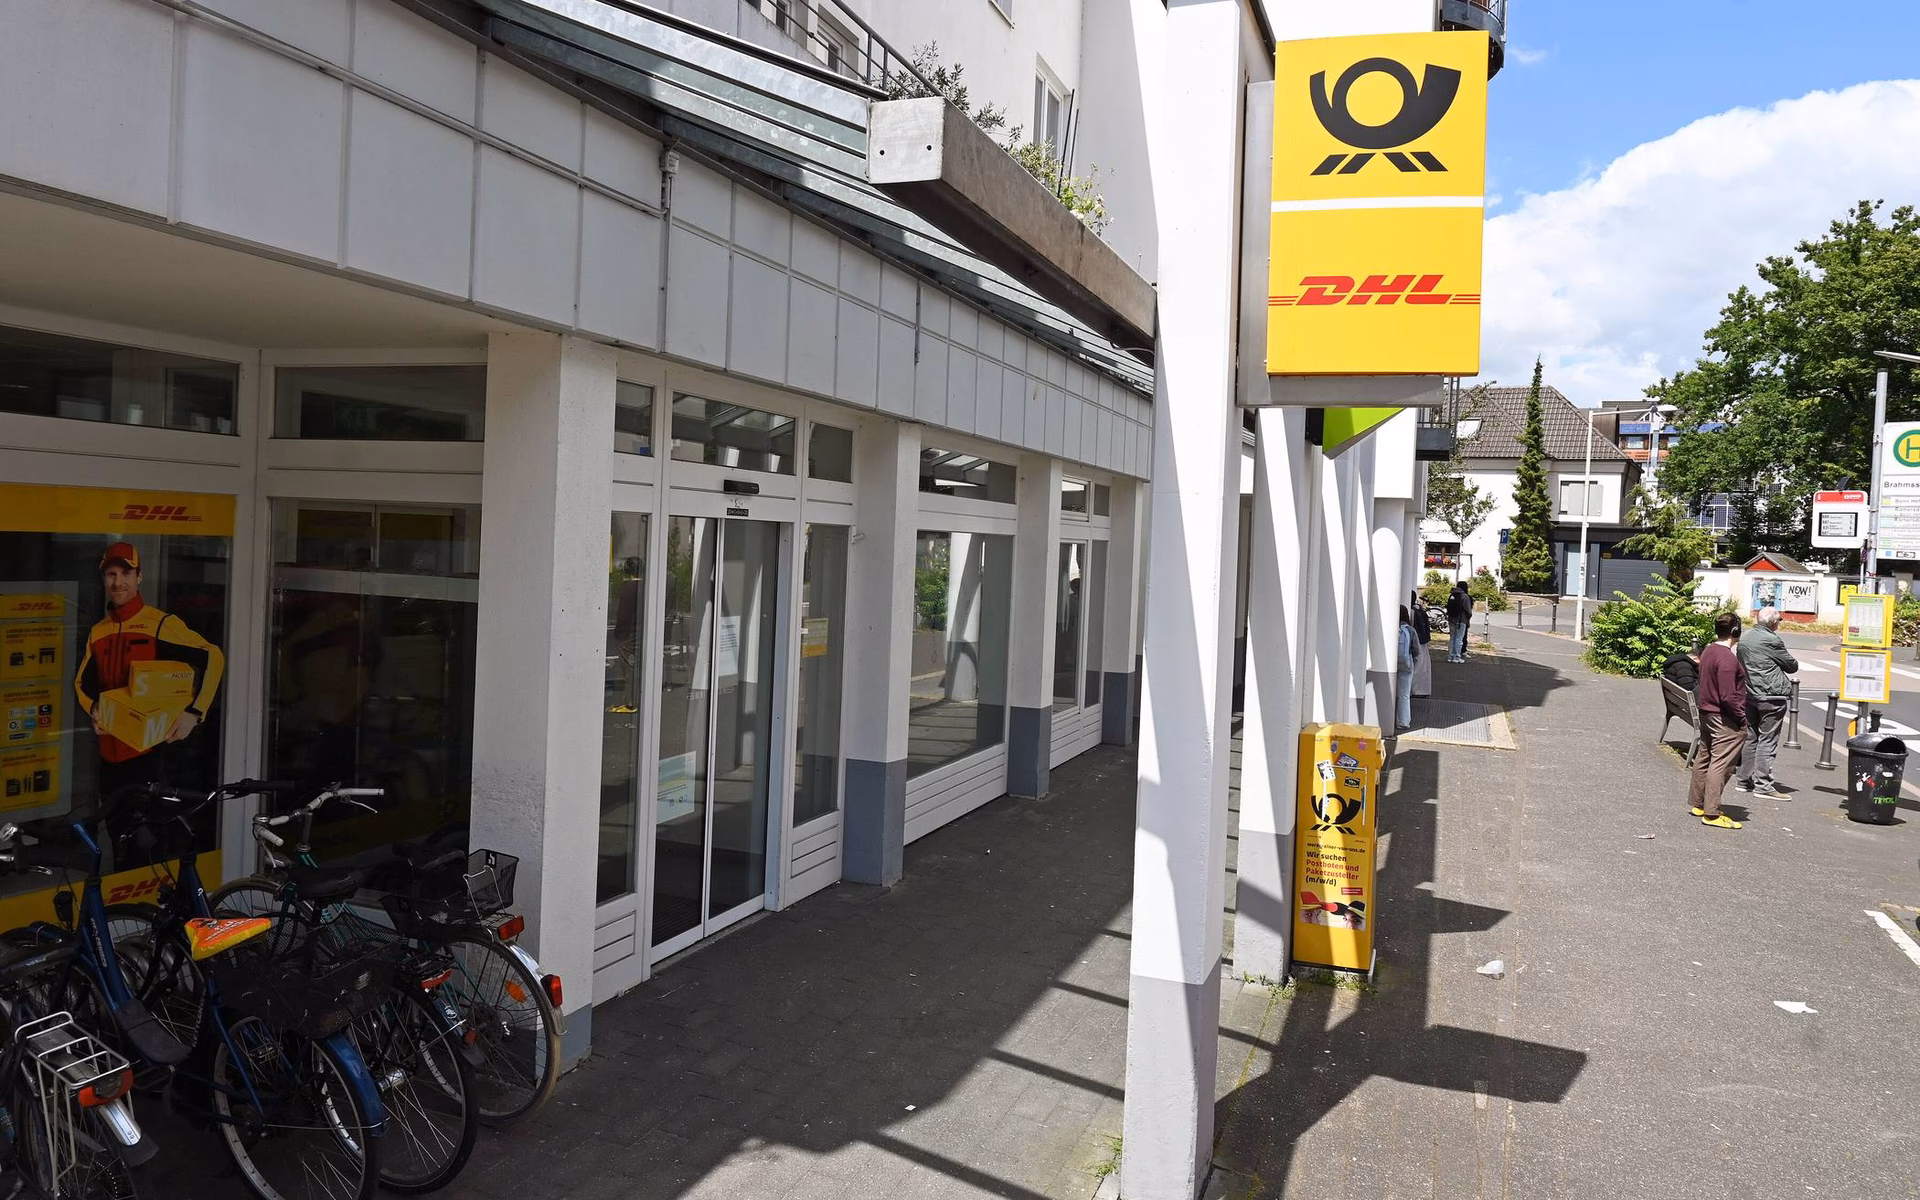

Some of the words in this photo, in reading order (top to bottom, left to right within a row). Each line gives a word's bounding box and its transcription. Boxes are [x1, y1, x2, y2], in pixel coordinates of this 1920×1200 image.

[1296, 274, 1453, 306] DHL
[122, 504, 192, 522] DHL
[1502, 530, 1508, 542] P
[1788, 585, 1812, 596] NOW!
[134, 674, 149, 696] S
[143, 712, 168, 748] M
[1306, 851, 1320, 859] Wir
[1320, 853, 1347, 862] suchen
[1306, 859, 1344, 870] Postboten
[1306, 867, 1359, 880] Paketzusteller
[1306, 876, 1337, 887] (m/w/d)
